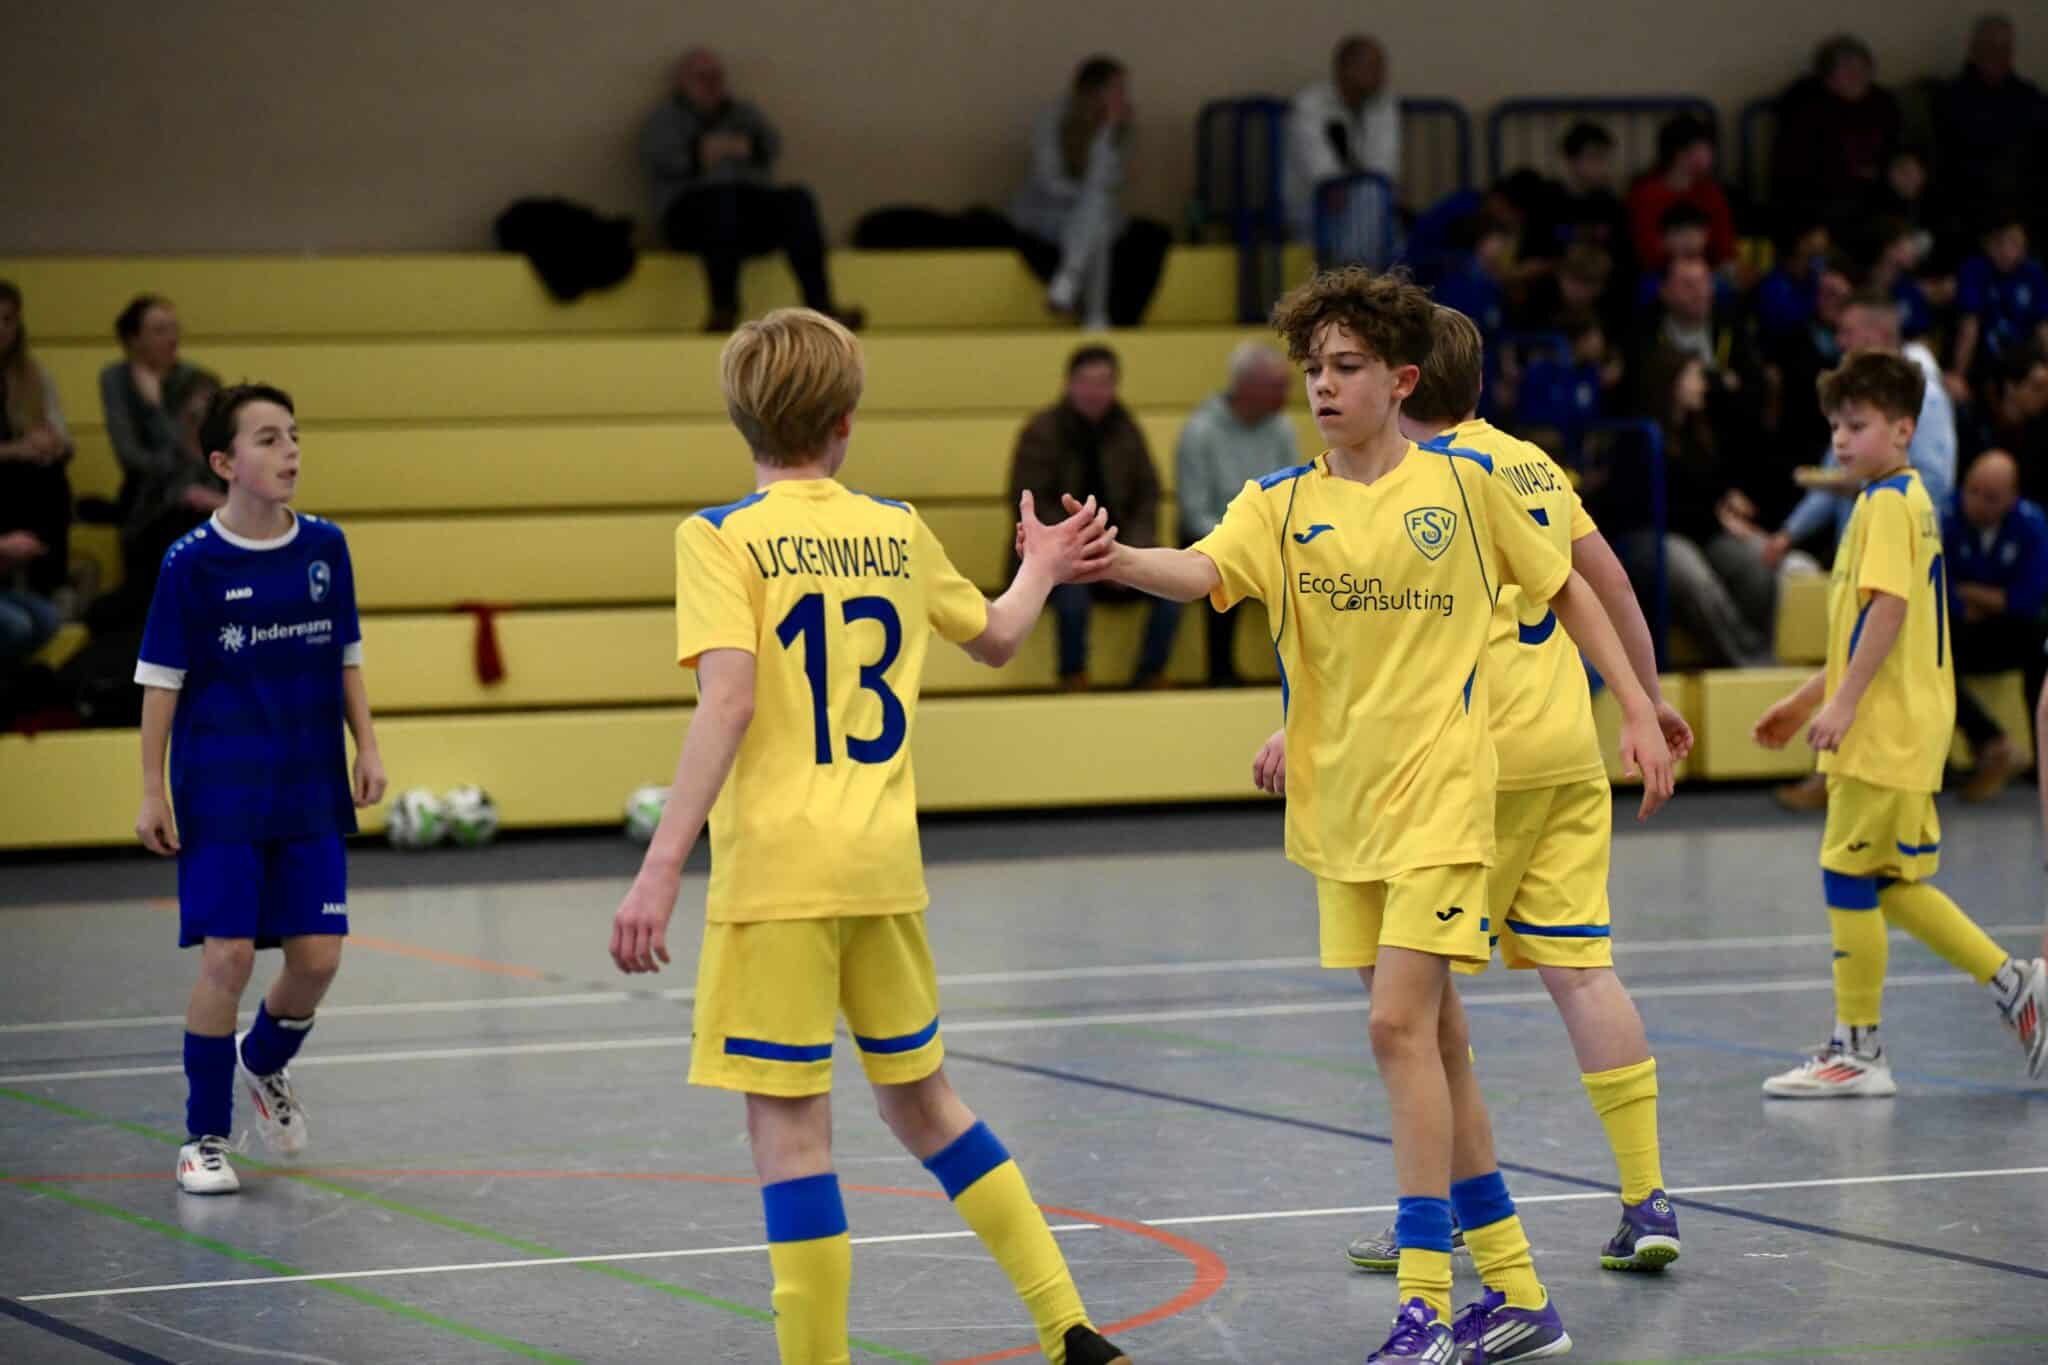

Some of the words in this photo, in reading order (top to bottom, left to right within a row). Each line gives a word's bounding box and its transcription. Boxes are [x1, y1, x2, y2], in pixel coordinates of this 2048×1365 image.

[225, 586, 253, 600] JAKO
[1331, 587, 1454, 617] Consulting
[775, 593, 906, 764] 13
